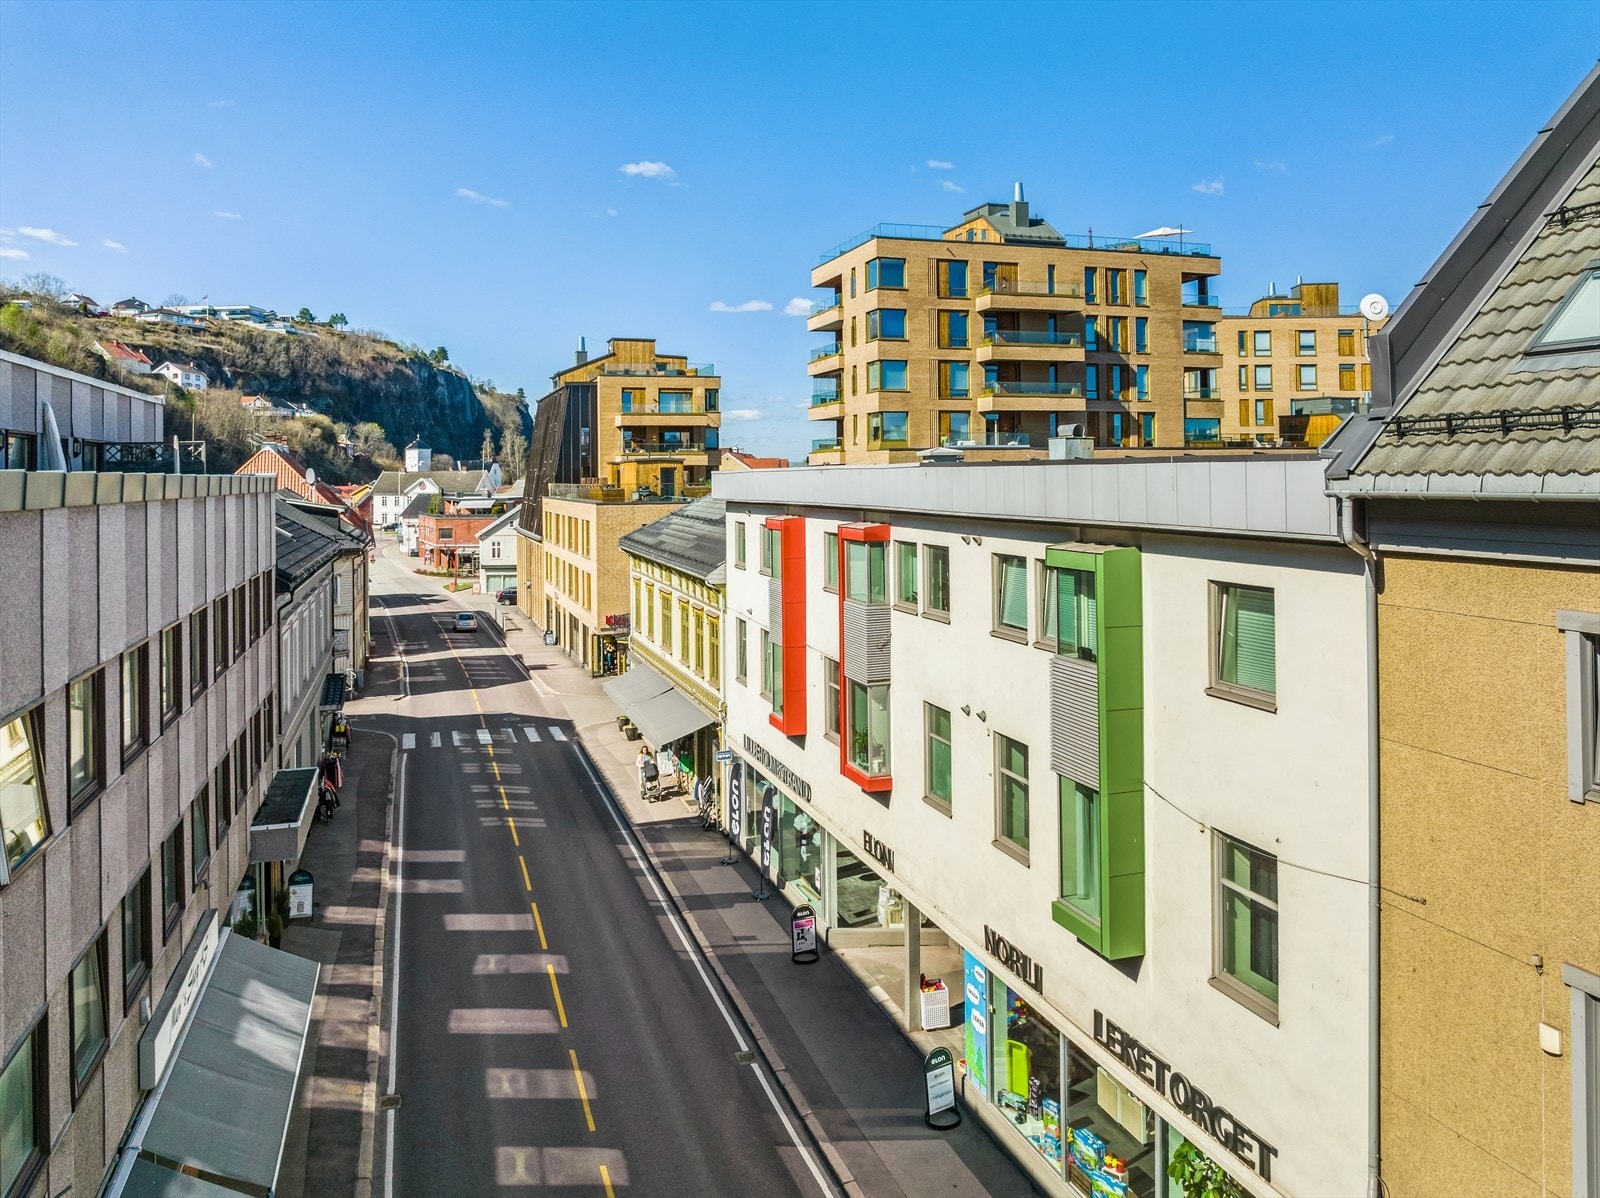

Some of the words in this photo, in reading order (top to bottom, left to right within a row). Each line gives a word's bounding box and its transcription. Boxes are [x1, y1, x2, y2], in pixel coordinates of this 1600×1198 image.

[863, 829, 894, 873] ELON
[984, 924, 1043, 995] NORLI
[1093, 1008, 1279, 1184] LEKETORGET
